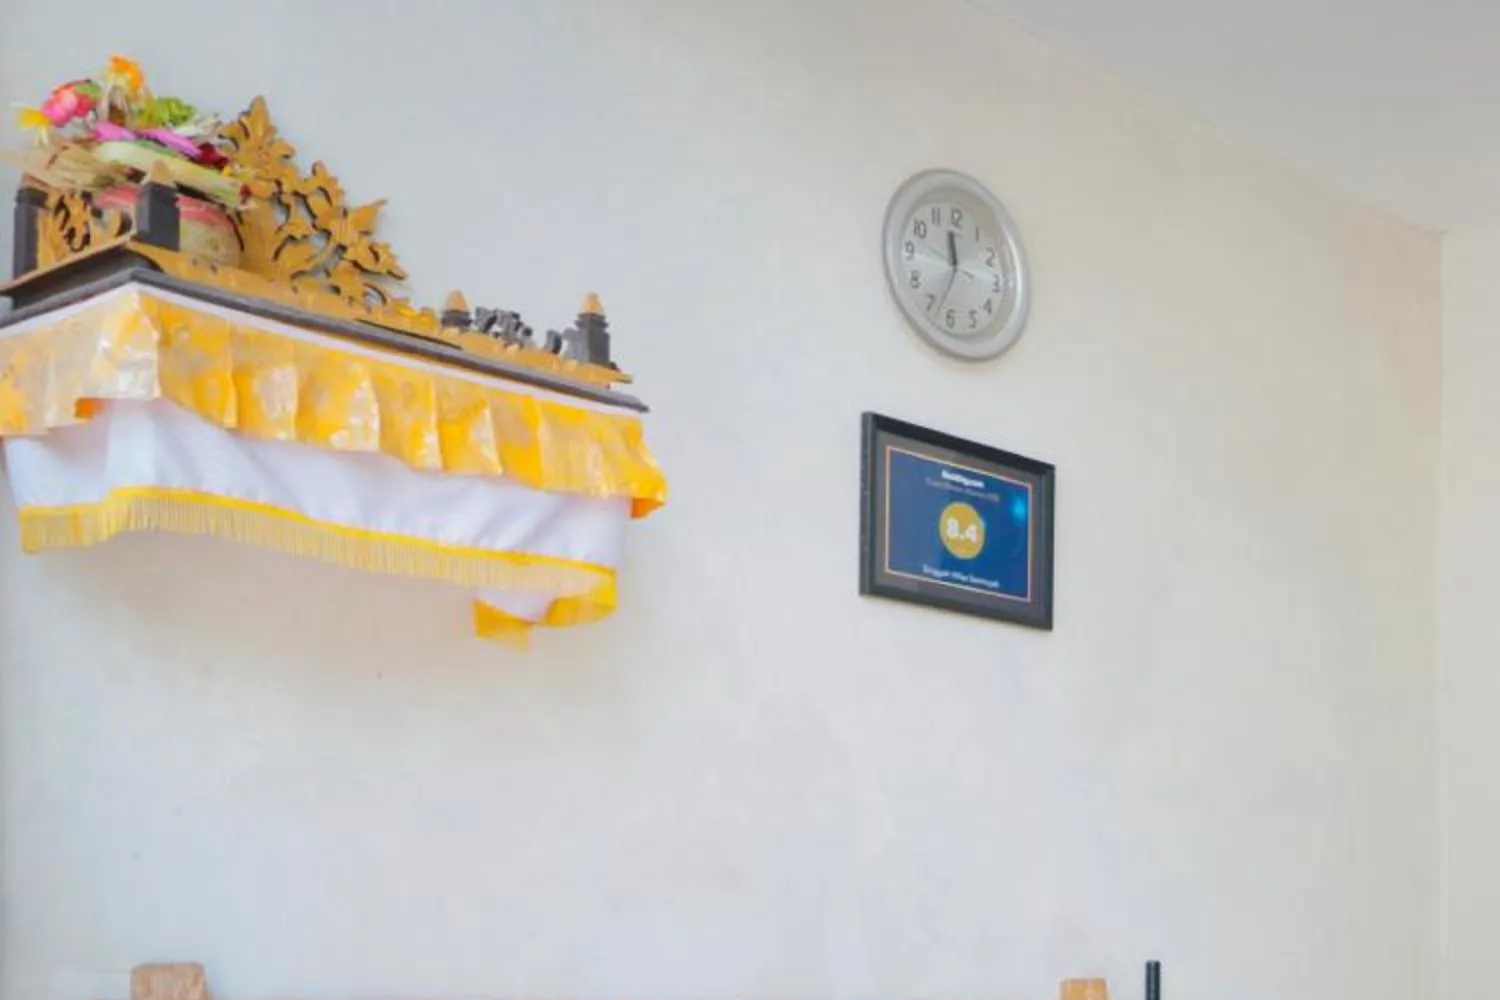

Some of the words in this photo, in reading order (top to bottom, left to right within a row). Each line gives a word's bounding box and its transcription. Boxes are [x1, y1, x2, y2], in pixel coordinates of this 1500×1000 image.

[931, 207, 940, 226] 11
[951, 207, 963, 229] 12
[914, 219, 927, 239] 10
[905, 241, 915, 260] 9
[985, 247, 995, 267] 2
[910, 269, 920, 289] 8
[992, 274, 1001, 293] 3
[926, 293, 936, 312] 7
[983, 298, 992, 315] 4
[946, 308, 956, 329] 6
